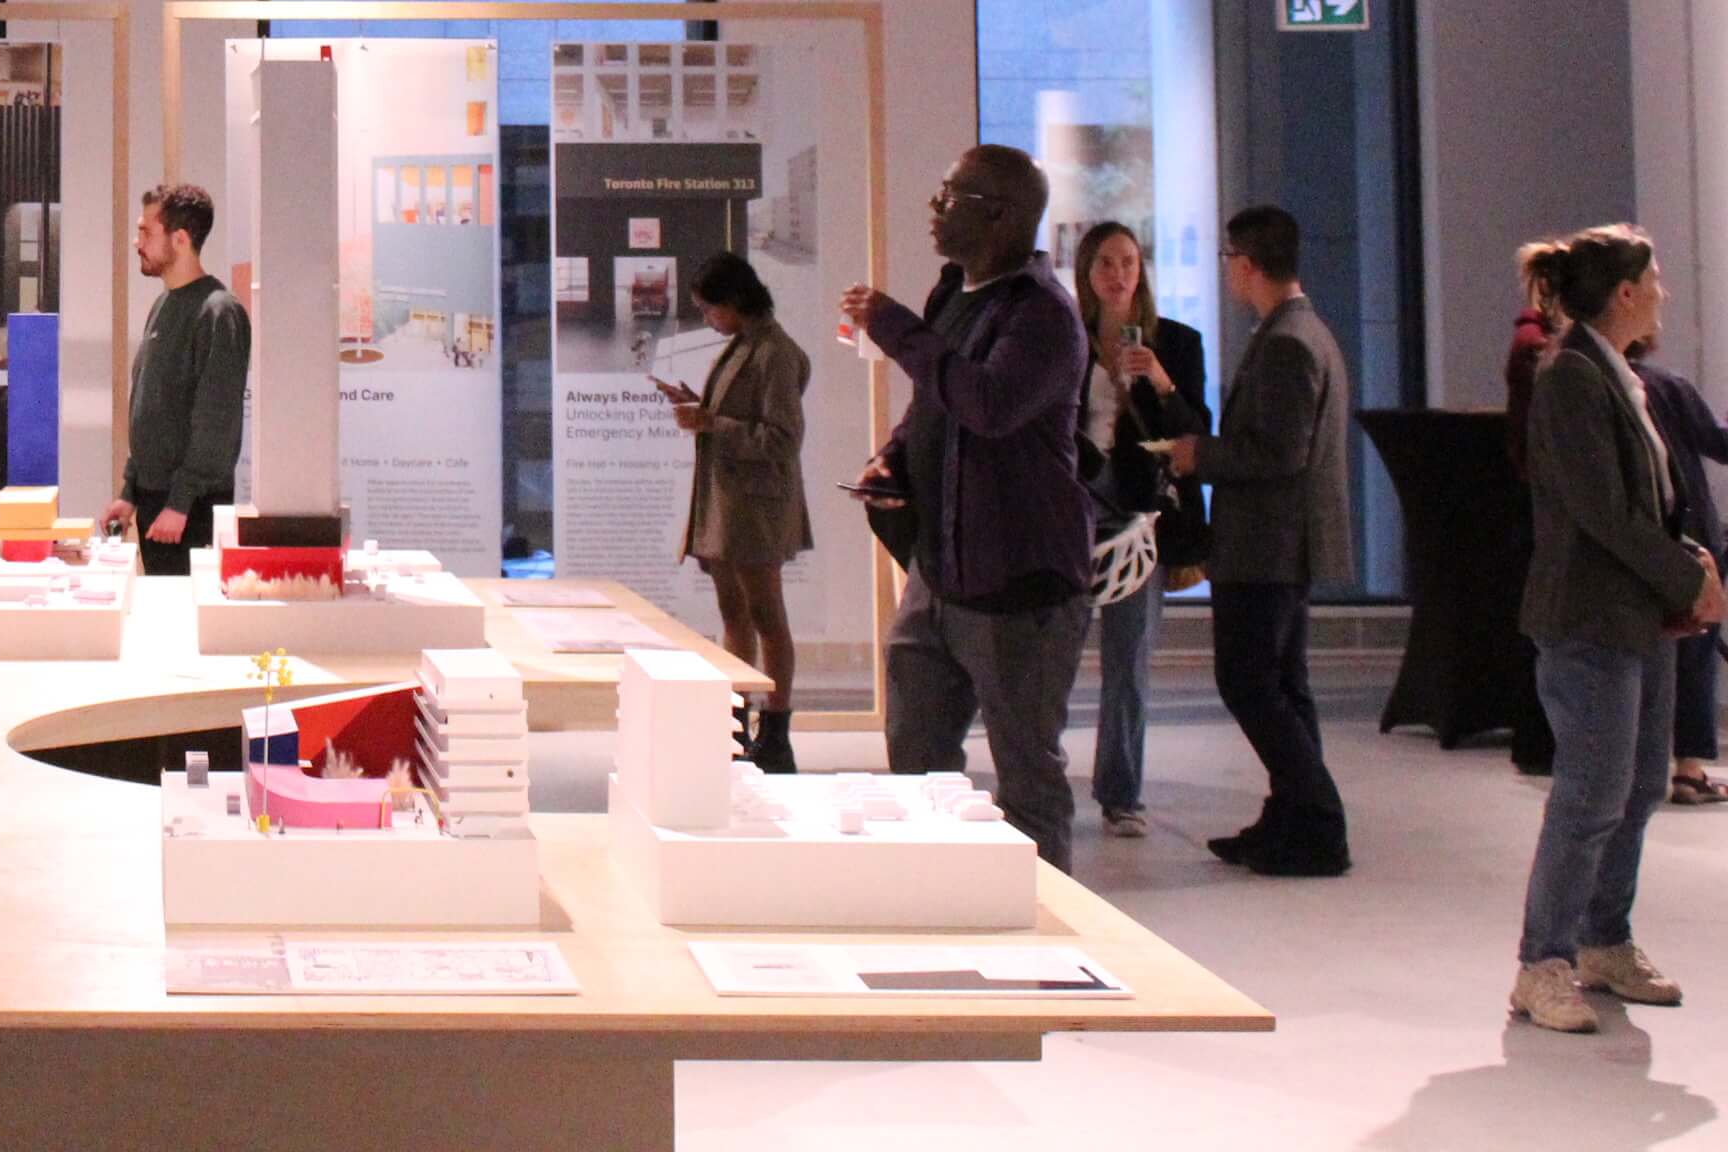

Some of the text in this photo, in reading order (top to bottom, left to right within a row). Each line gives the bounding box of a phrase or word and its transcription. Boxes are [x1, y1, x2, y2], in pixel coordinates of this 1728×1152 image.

[604, 178, 654, 190] Toronto
[656, 178, 681, 190] Fire
[684, 178, 729, 190] Station
[361, 389, 394, 401] Care
[566, 391, 666, 405] Always Ready
[566, 408, 673, 423] Unlocking Publi
[566, 426, 643, 441] Emergency
